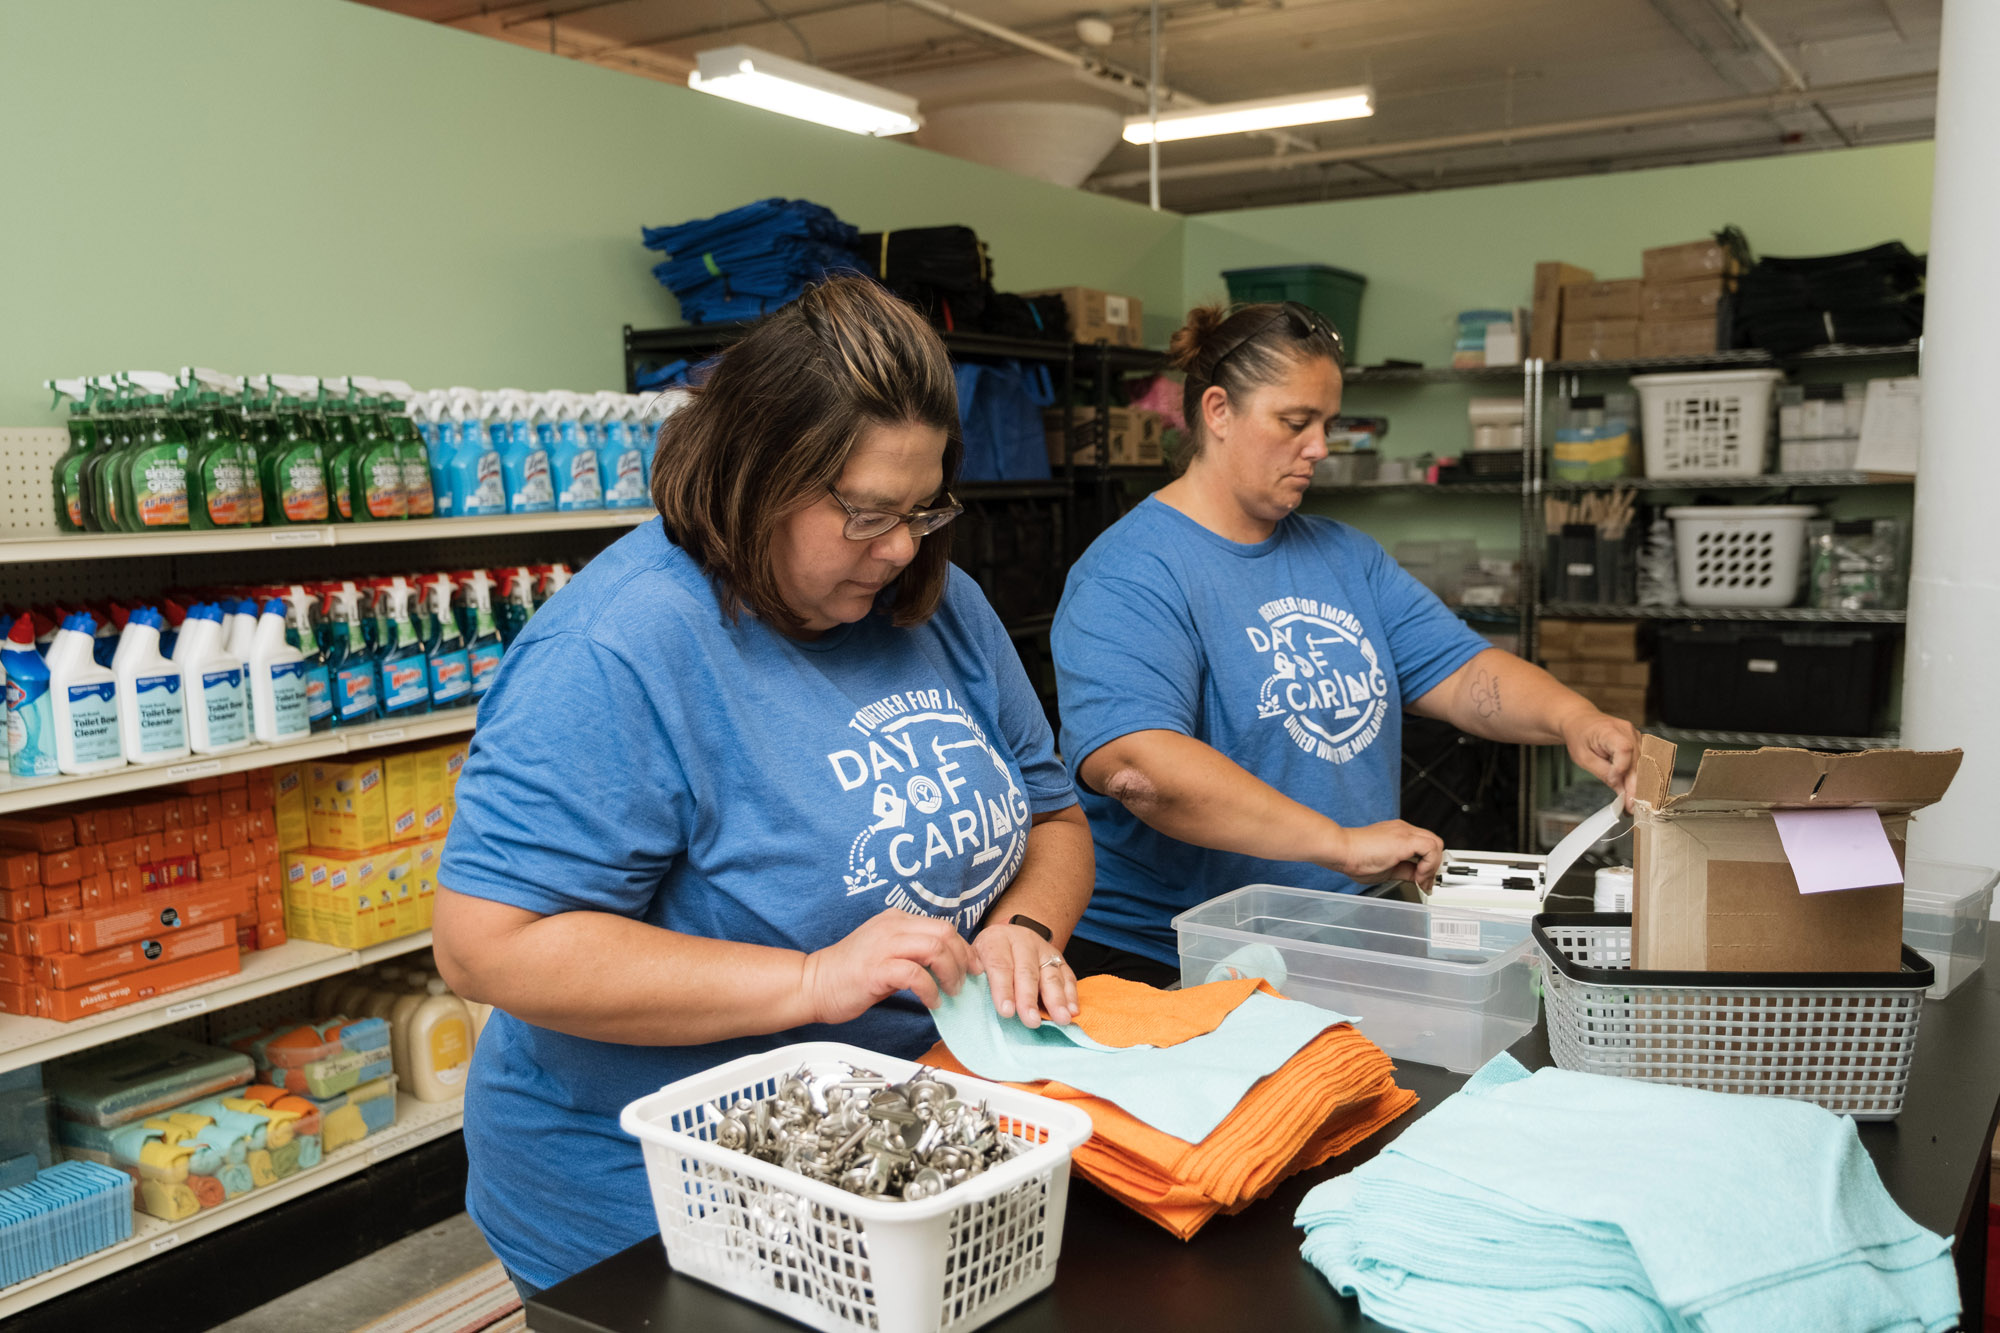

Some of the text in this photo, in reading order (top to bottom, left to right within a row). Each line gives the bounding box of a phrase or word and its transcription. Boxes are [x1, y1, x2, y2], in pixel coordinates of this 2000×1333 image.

[1320, 602, 1364, 636] IMPACT
[1246, 626, 1296, 653] DAY
[905, 688, 942, 711] FOR
[1286, 669, 1388, 713] CARING
[74, 718, 99, 728] Toilet
[141, 709, 166, 718] Toilet
[141, 718, 174, 728] Cleaner
[74, 727, 109, 738] Cleaner
[1283, 713, 1317, 753] UNITED
[1350, 698, 1388, 755] MIDLANDS
[827, 731, 920, 792] DAY
[889, 789, 1029, 877] CARING
[80, 991, 108, 1008] plastic
[109, 987, 132, 999] wrap
